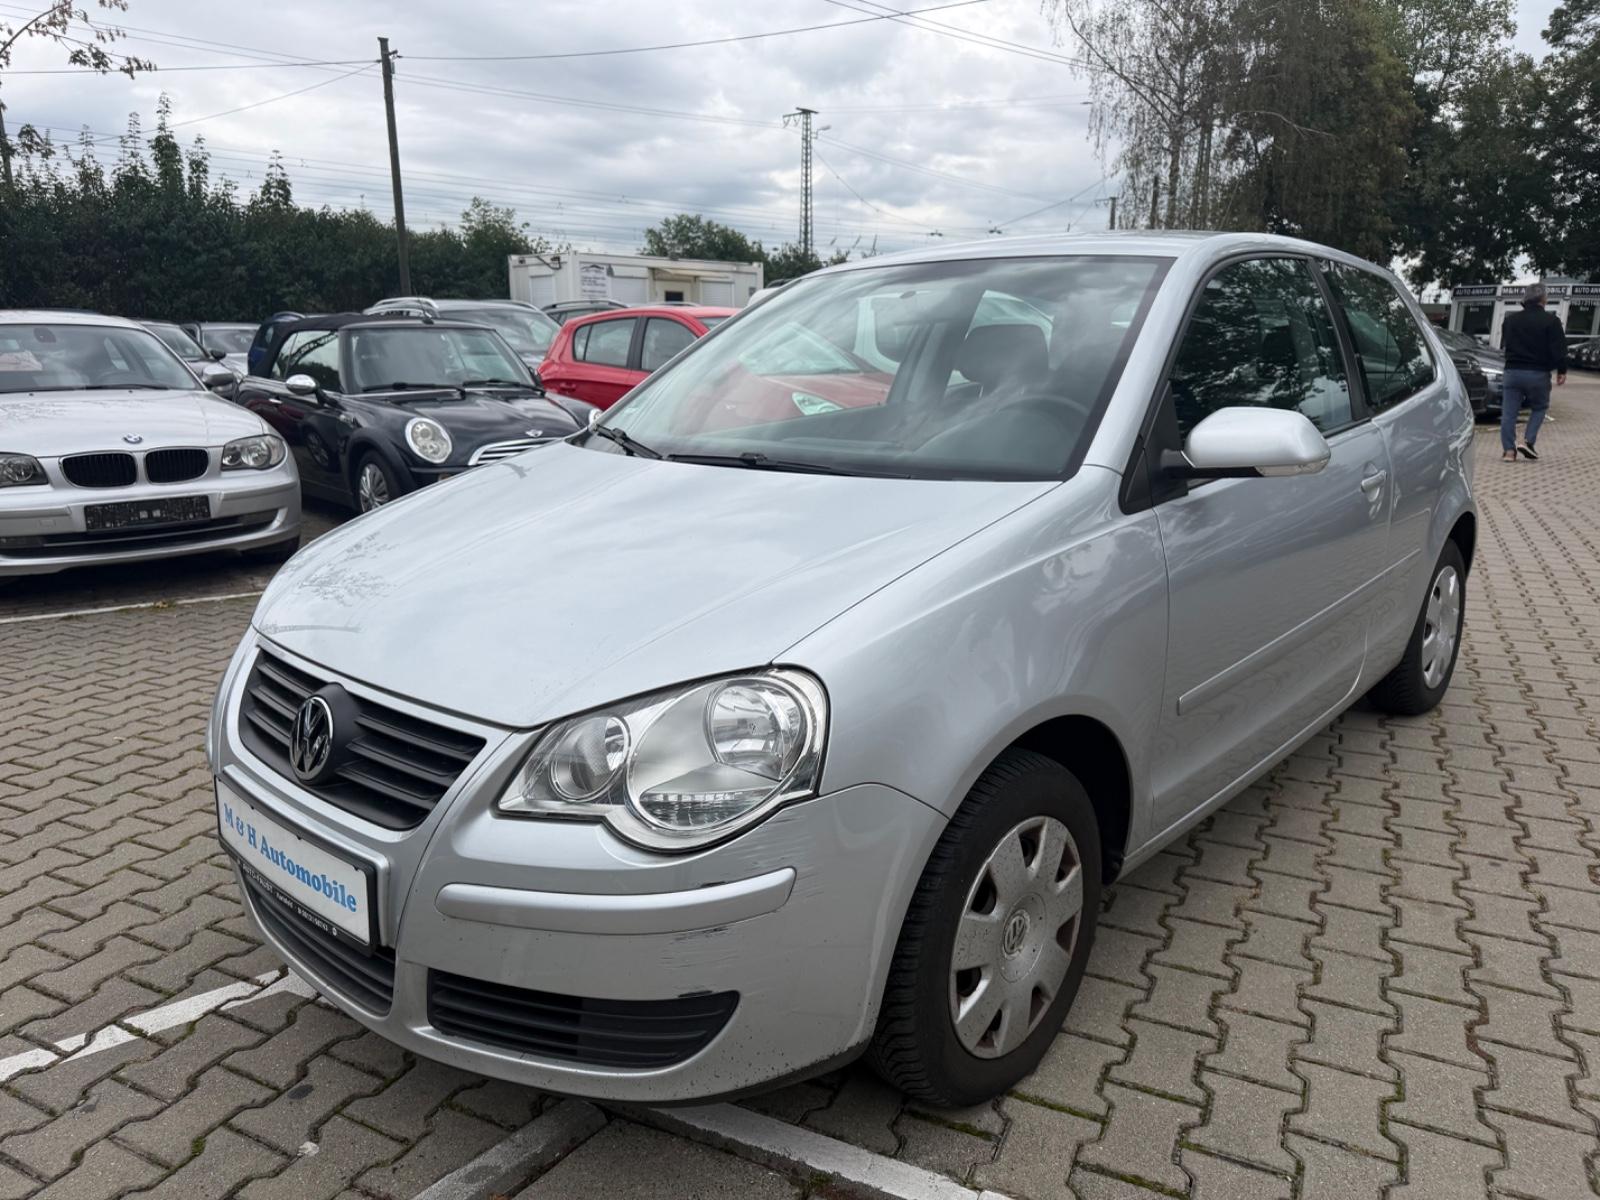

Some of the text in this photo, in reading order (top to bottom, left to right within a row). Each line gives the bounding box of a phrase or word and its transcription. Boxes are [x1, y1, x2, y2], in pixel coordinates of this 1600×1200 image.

[224, 803, 233, 828] M
[236, 817, 245, 837] &
[247, 823, 257, 849] H
[260, 835, 357, 912] Automobile
